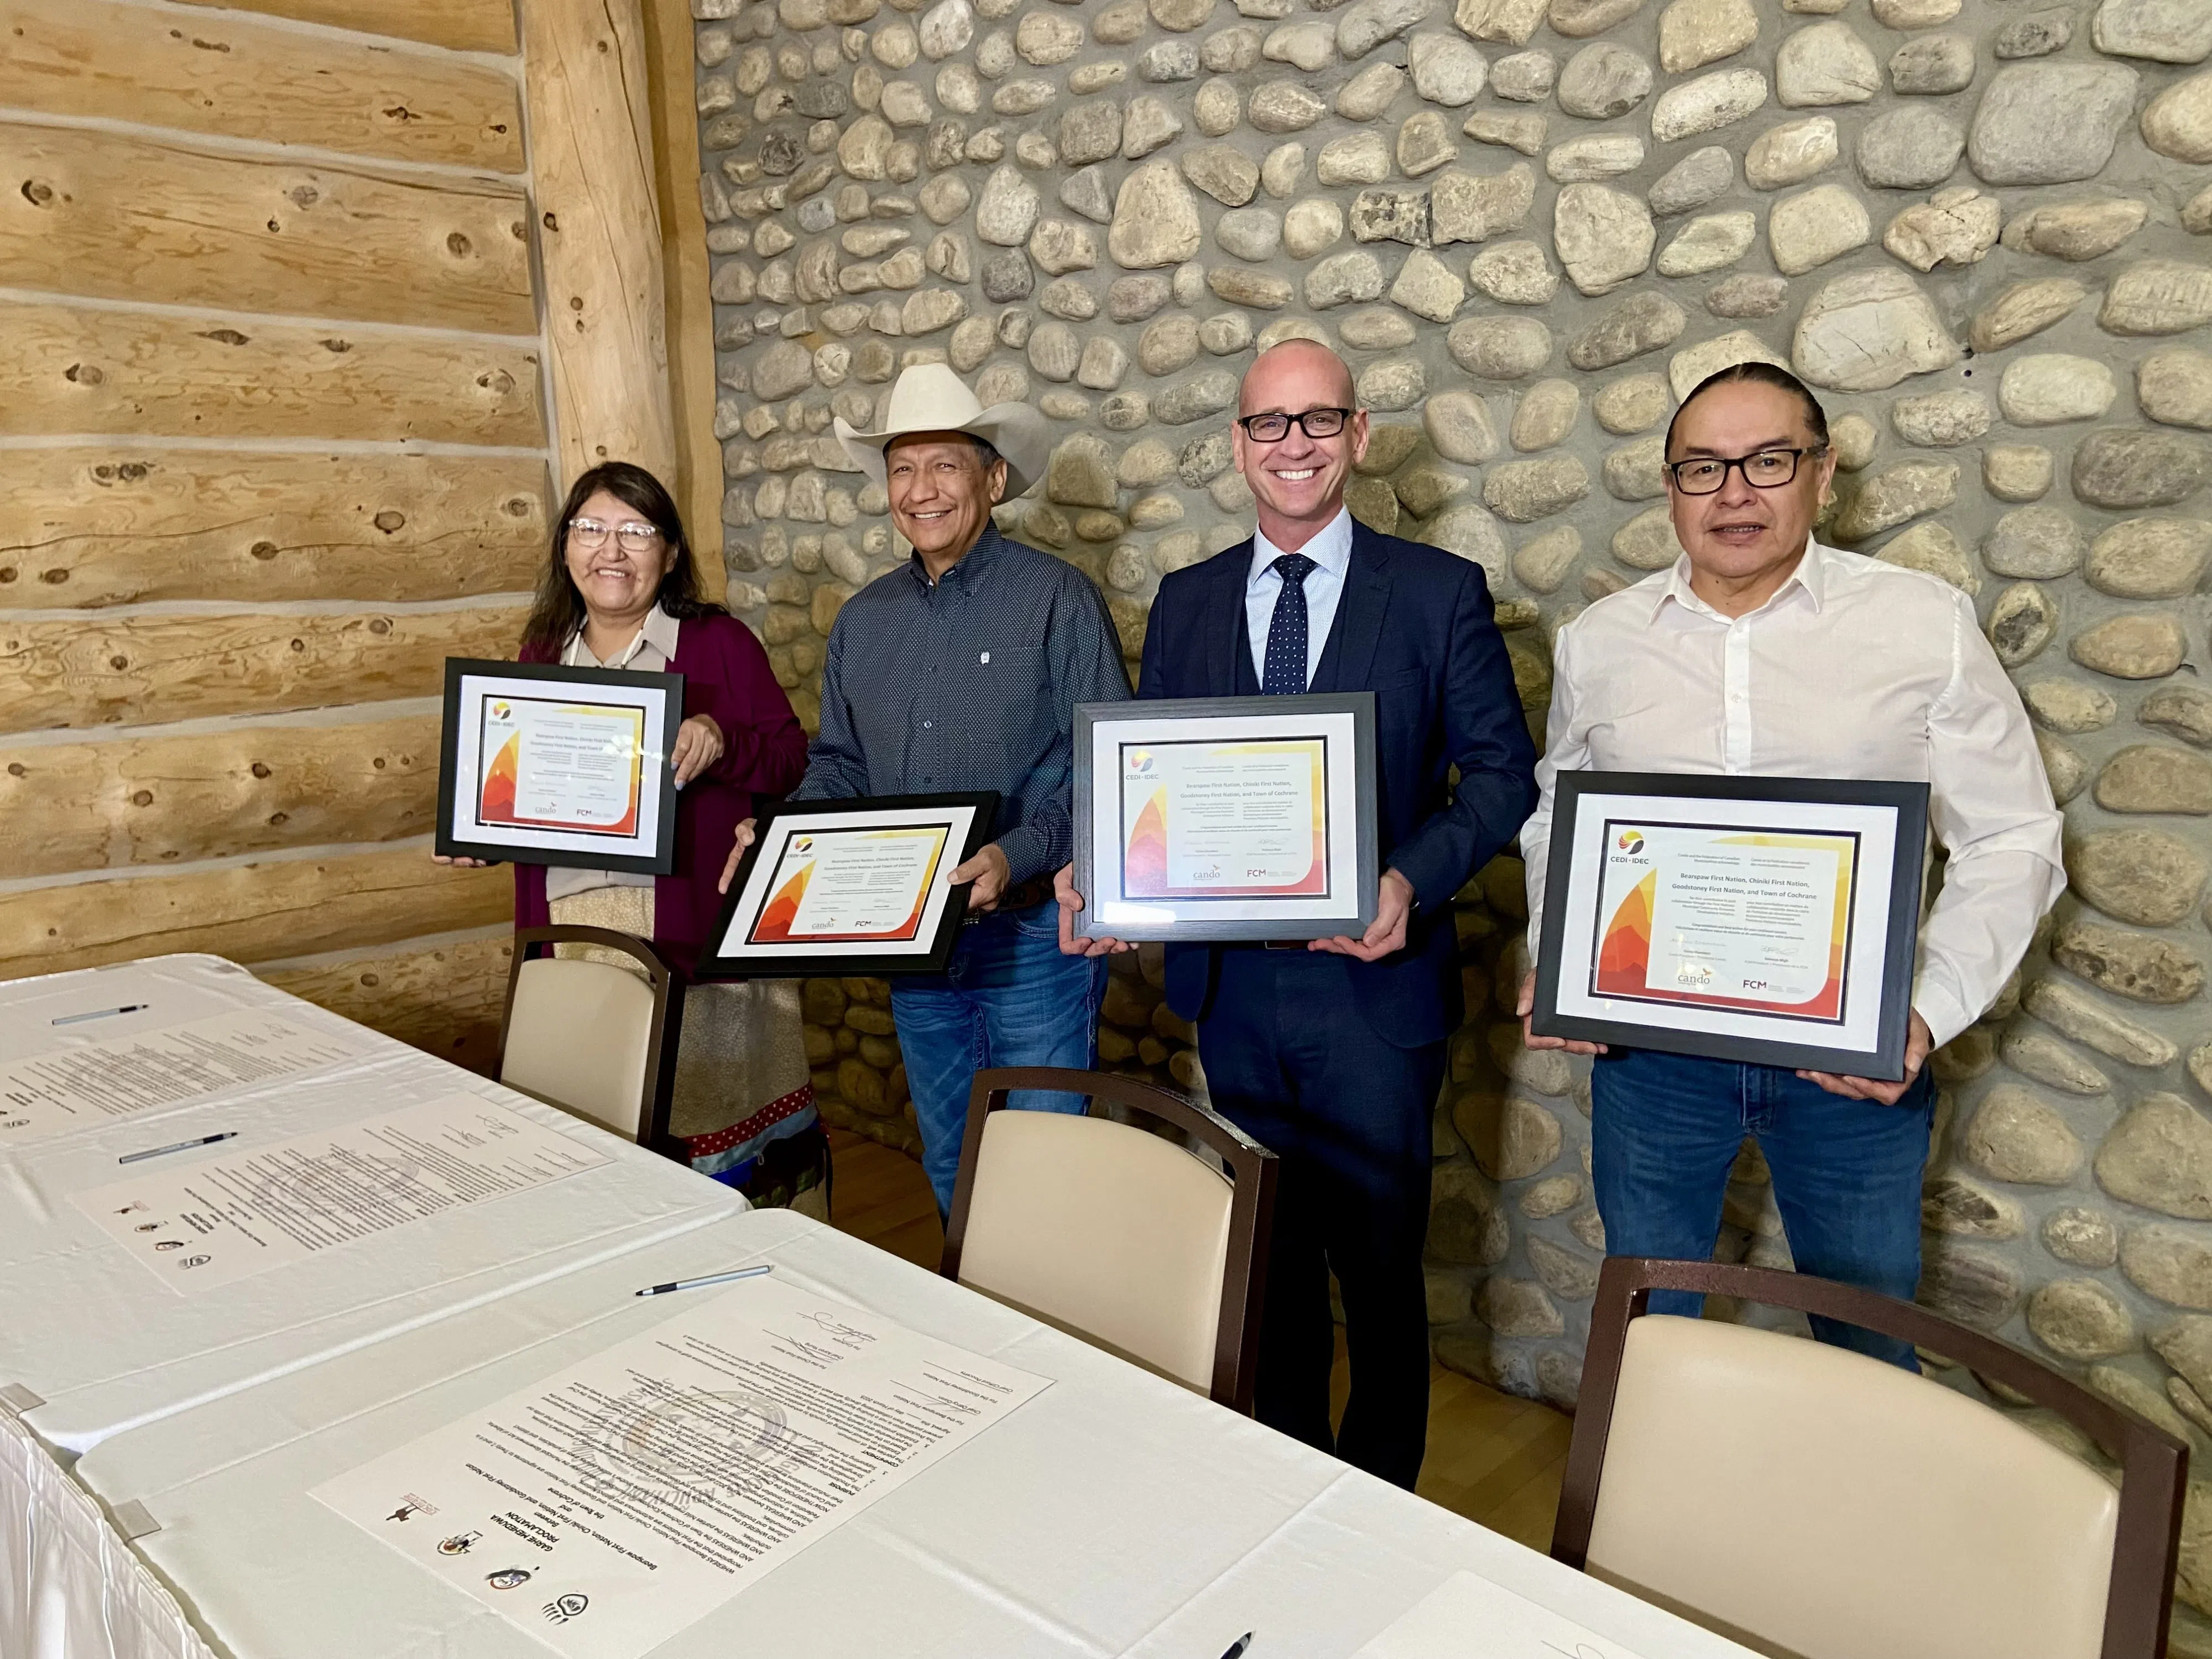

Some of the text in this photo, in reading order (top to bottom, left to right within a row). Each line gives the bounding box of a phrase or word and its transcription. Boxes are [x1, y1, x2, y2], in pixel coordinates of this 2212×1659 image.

[1193, 870, 1220, 878] cando
[1672, 884, 1707, 892] Goodstoney
[1678, 974, 1710, 984] cando
[1743, 980, 1766, 989] FCM
[860, 1449, 899, 1467] COMMITMENT
[545, 1487, 575, 1503] Cochrane
[827, 1481, 856, 1496] PURPOSE
[558, 1504, 573, 1512] and
[577, 1504, 596, 1514] Town
[463, 1463, 659, 1570] Bearspaw First Nation, Chiniki First Nation, and Goodstoney First Nation
[531, 1511, 560, 1527] Between
[488, 1514, 554, 1552] GARHE MEHEDUWA
[504, 1511, 560, 1542] PROCLAMATION
